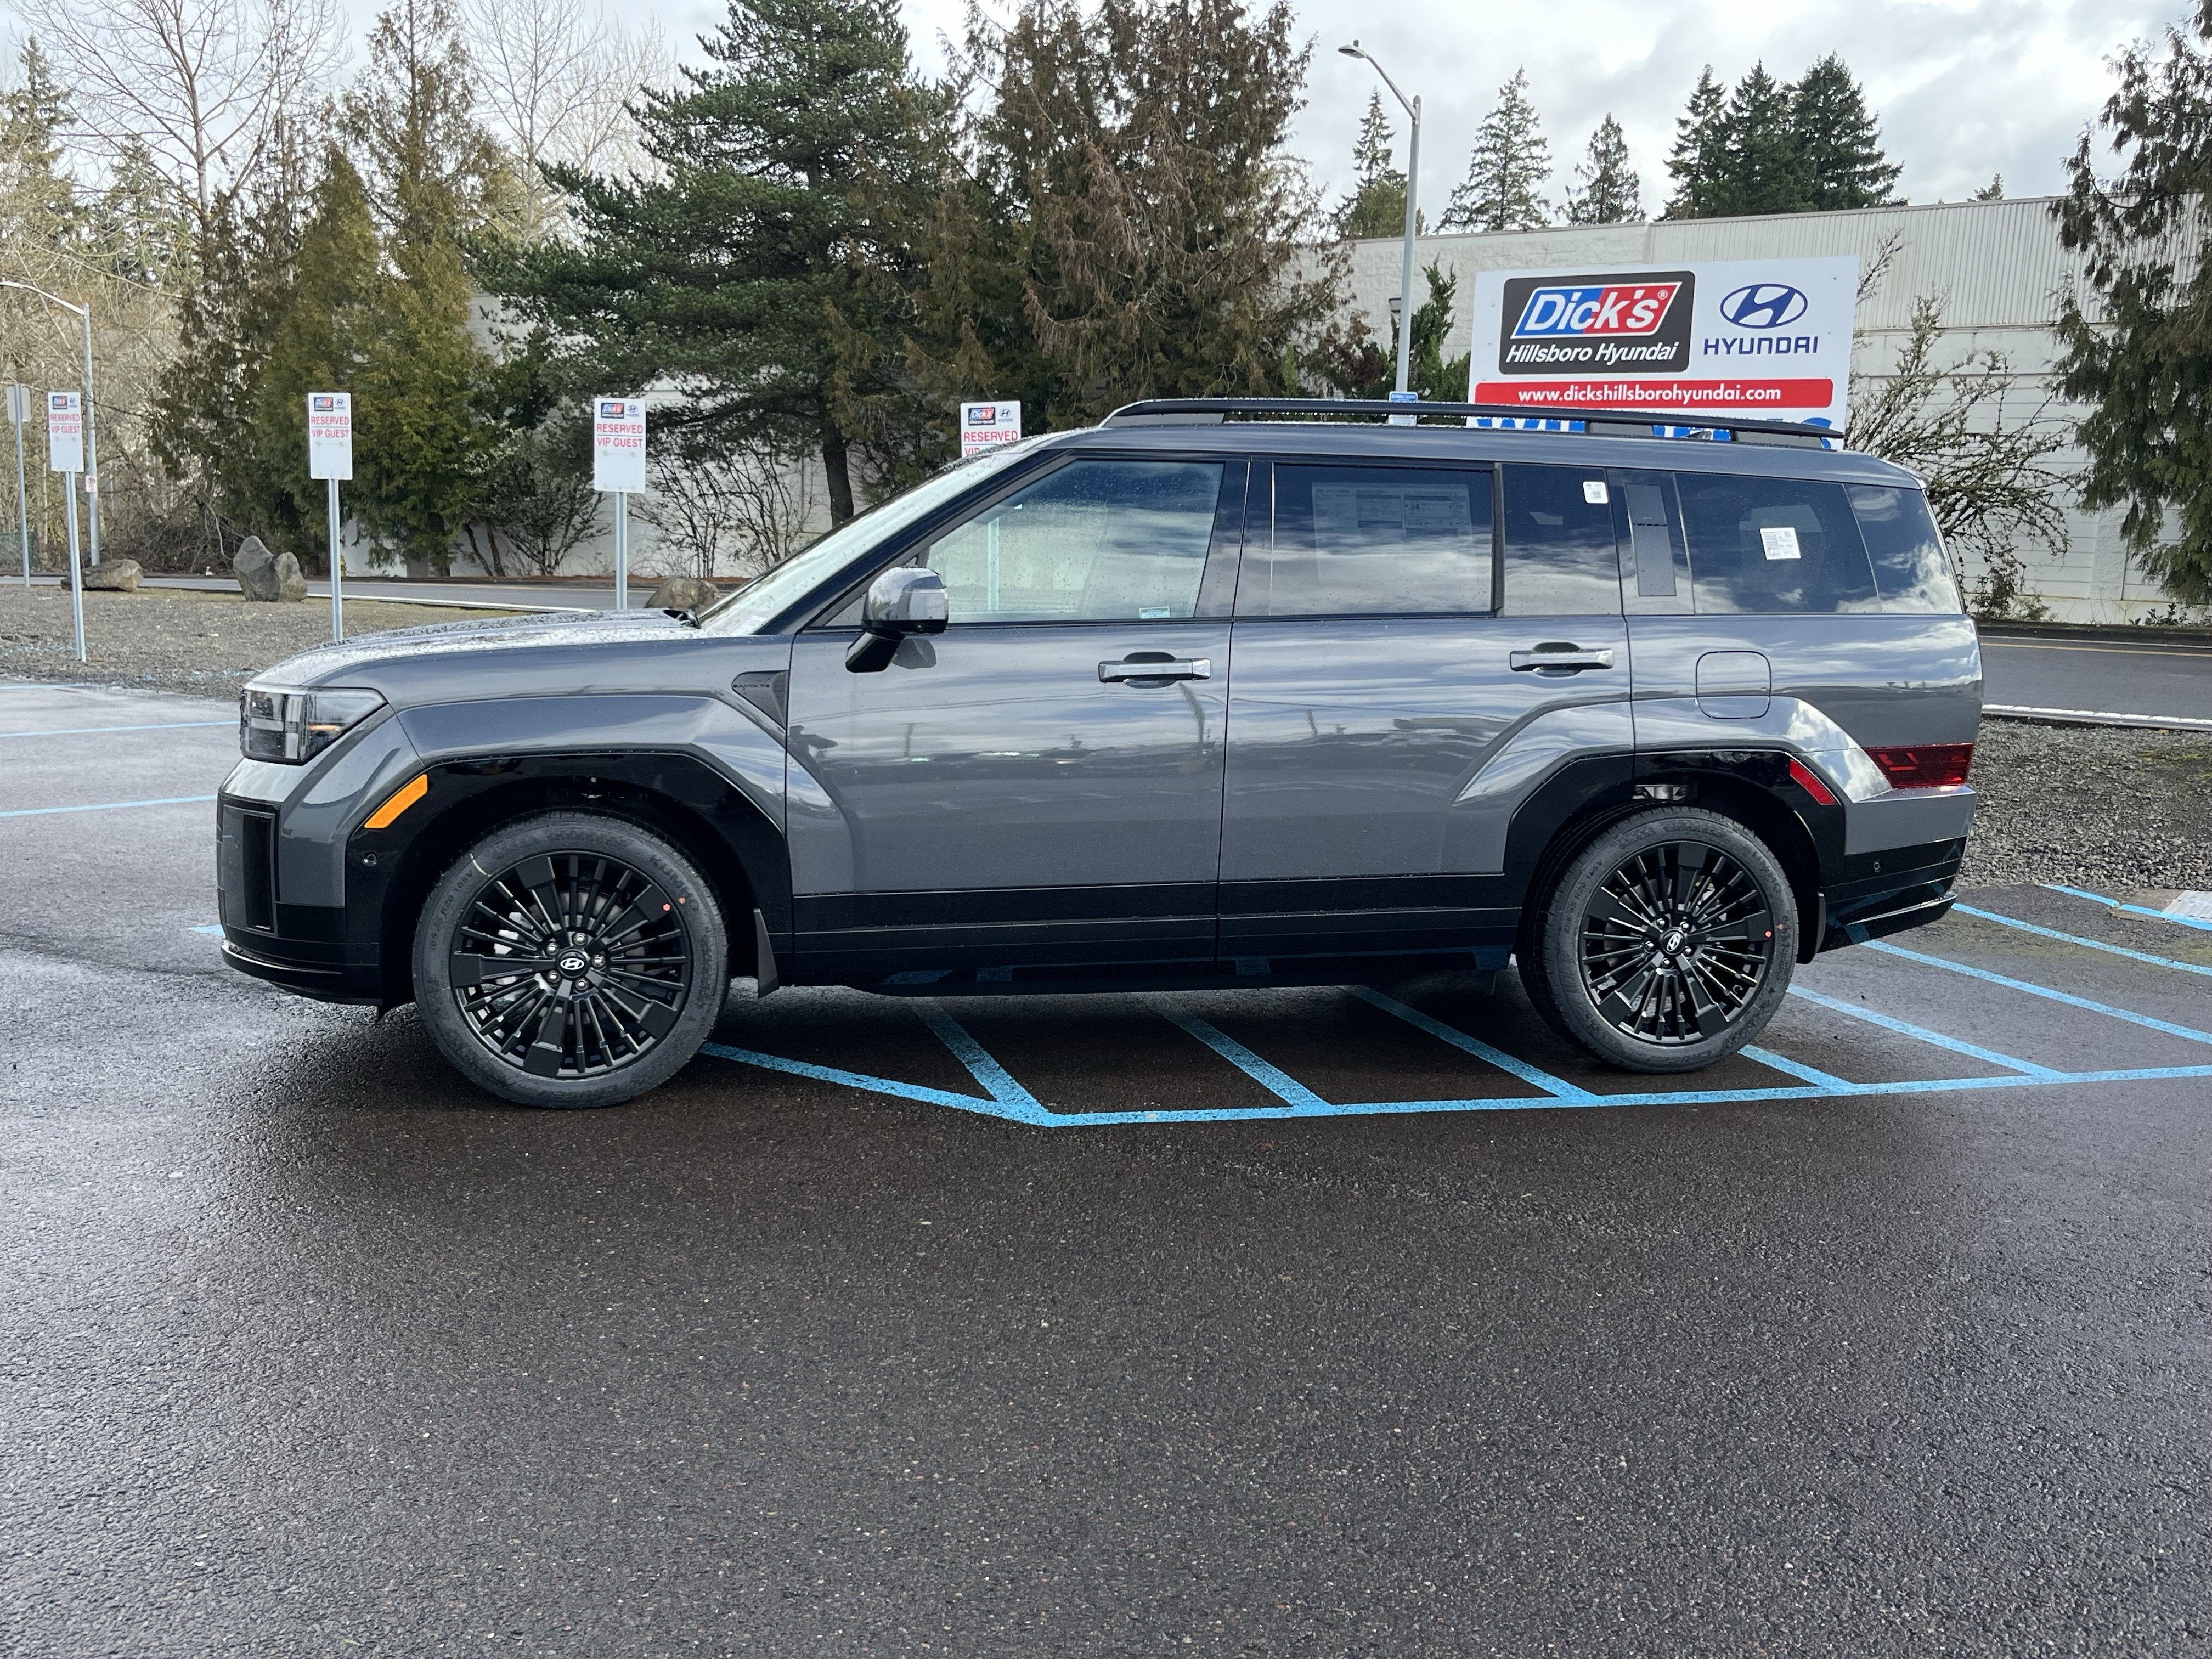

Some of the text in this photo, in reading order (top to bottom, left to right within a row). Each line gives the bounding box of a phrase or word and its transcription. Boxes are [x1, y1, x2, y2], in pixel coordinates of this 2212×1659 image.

[1523, 289, 1659, 332] Dick's
[1703, 336, 1819, 356] HYUNDAI
[1505, 341, 1680, 366] Hillsboro Hyundai
[1517, 383, 1781, 405] www.dickshillsborohyundai.com
[50, 414, 80, 422] RESERVED
[311, 416, 349, 425] RESERVED
[61, 425, 80, 434] GUEST
[597, 424, 643, 433] RESERVED
[312, 429, 349, 438] VIP GUEST
[963, 431, 1018, 442] RESERVED
[597, 438, 643, 447] VIP GUEST
